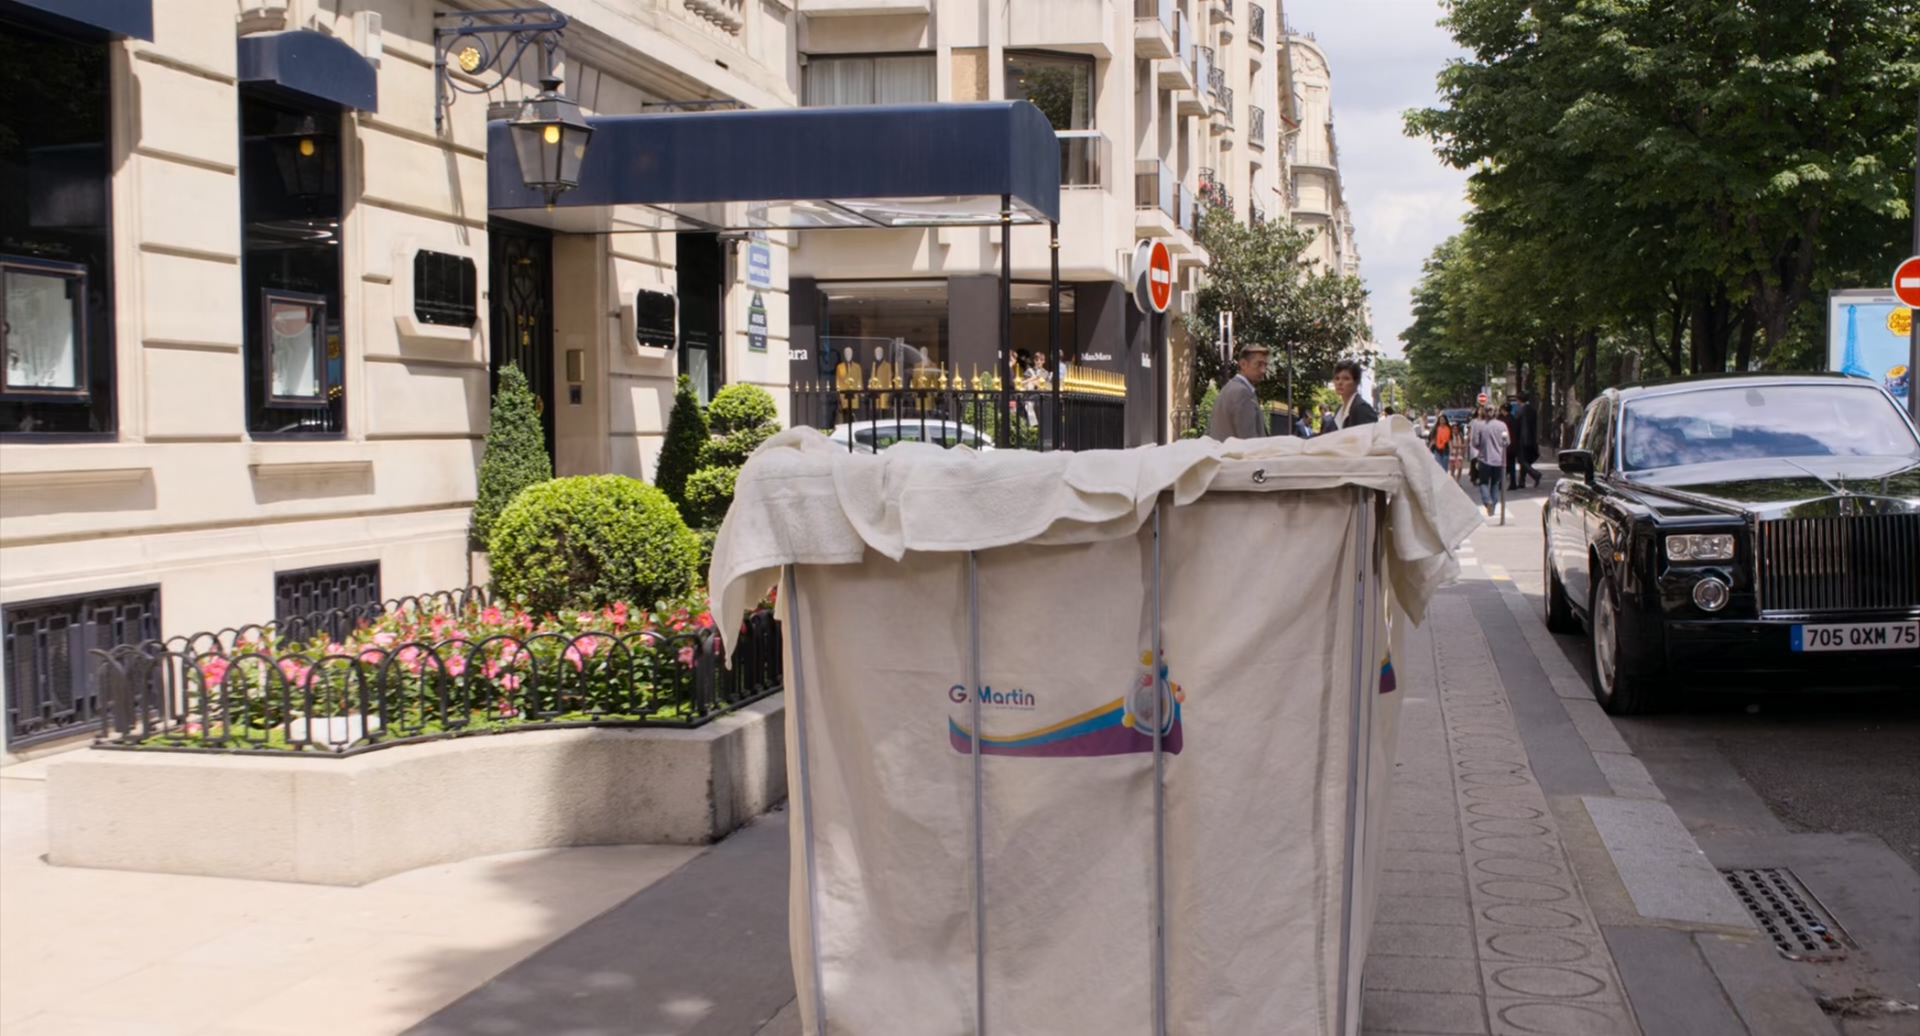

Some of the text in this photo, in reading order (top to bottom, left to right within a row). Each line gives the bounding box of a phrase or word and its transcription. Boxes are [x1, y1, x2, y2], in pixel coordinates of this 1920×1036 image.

[789, 349, 808, 360] ara
[1807, 625, 1916, 647] 705 QXM 75
[977, 685, 1035, 706] Martin
